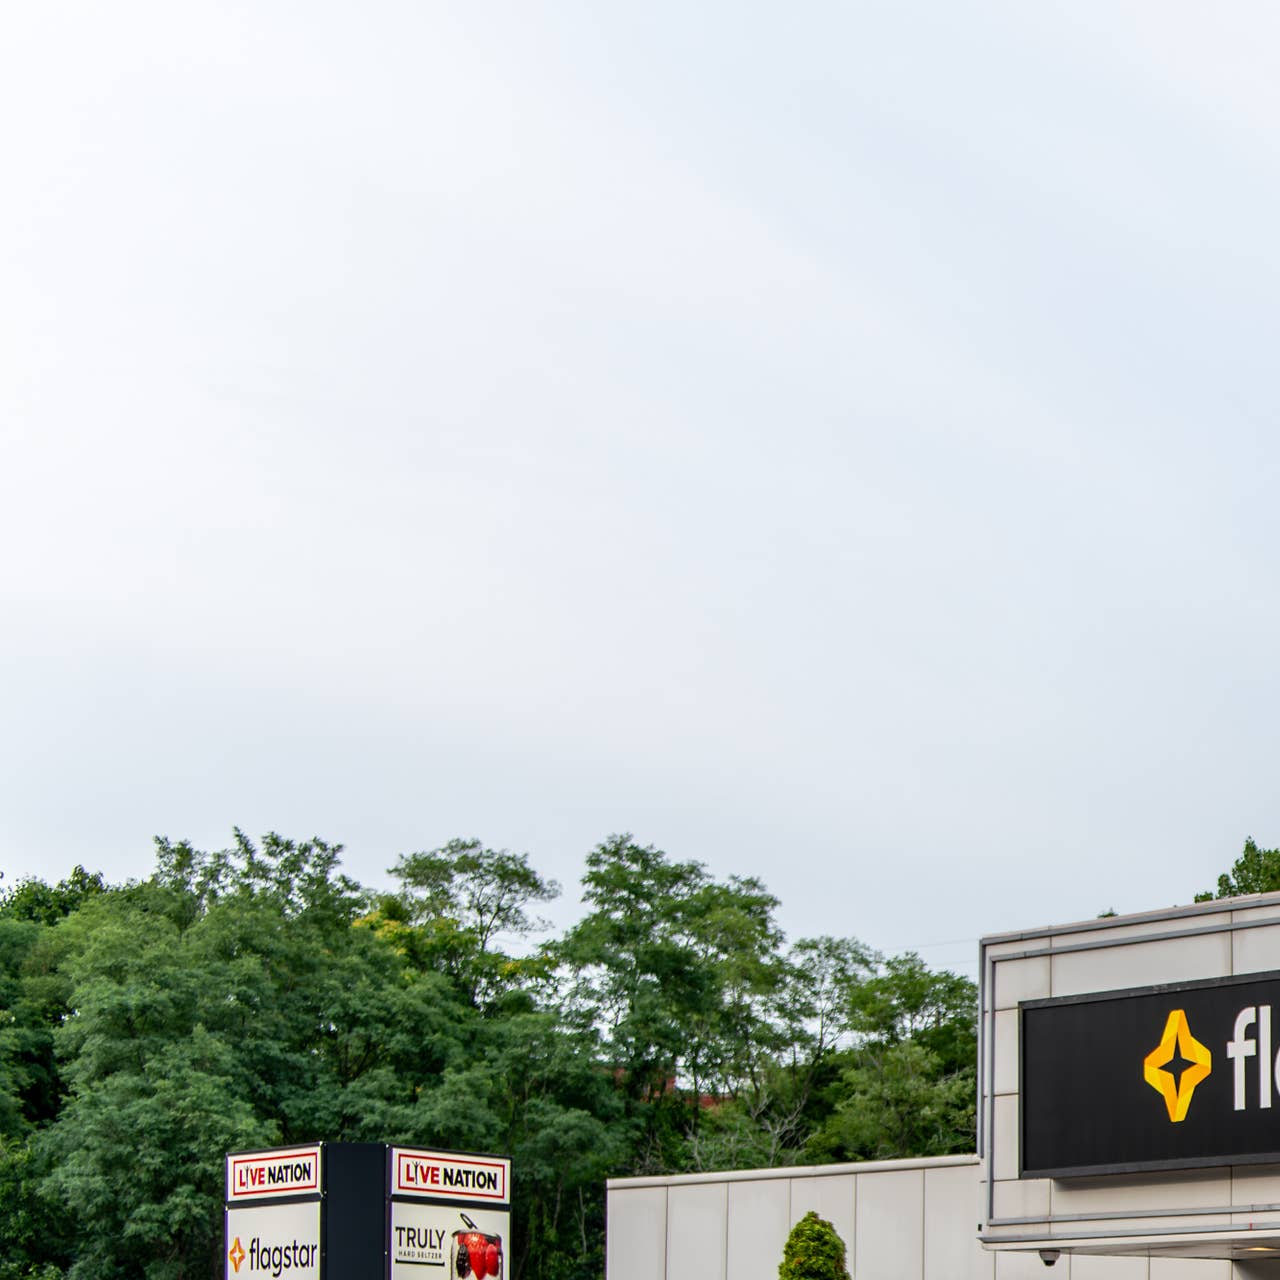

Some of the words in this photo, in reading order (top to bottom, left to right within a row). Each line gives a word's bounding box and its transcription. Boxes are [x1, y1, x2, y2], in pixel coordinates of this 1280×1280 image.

[239, 1166, 265, 1189] LIVE
[267, 1162, 311, 1185] NATION
[406, 1161, 440, 1186] LIVE
[443, 1168, 498, 1190] NATION
[395, 1226, 446, 1250] TRULY
[250, 1237, 317, 1278] flagstar
[418, 1252, 442, 1260] SELTZER
